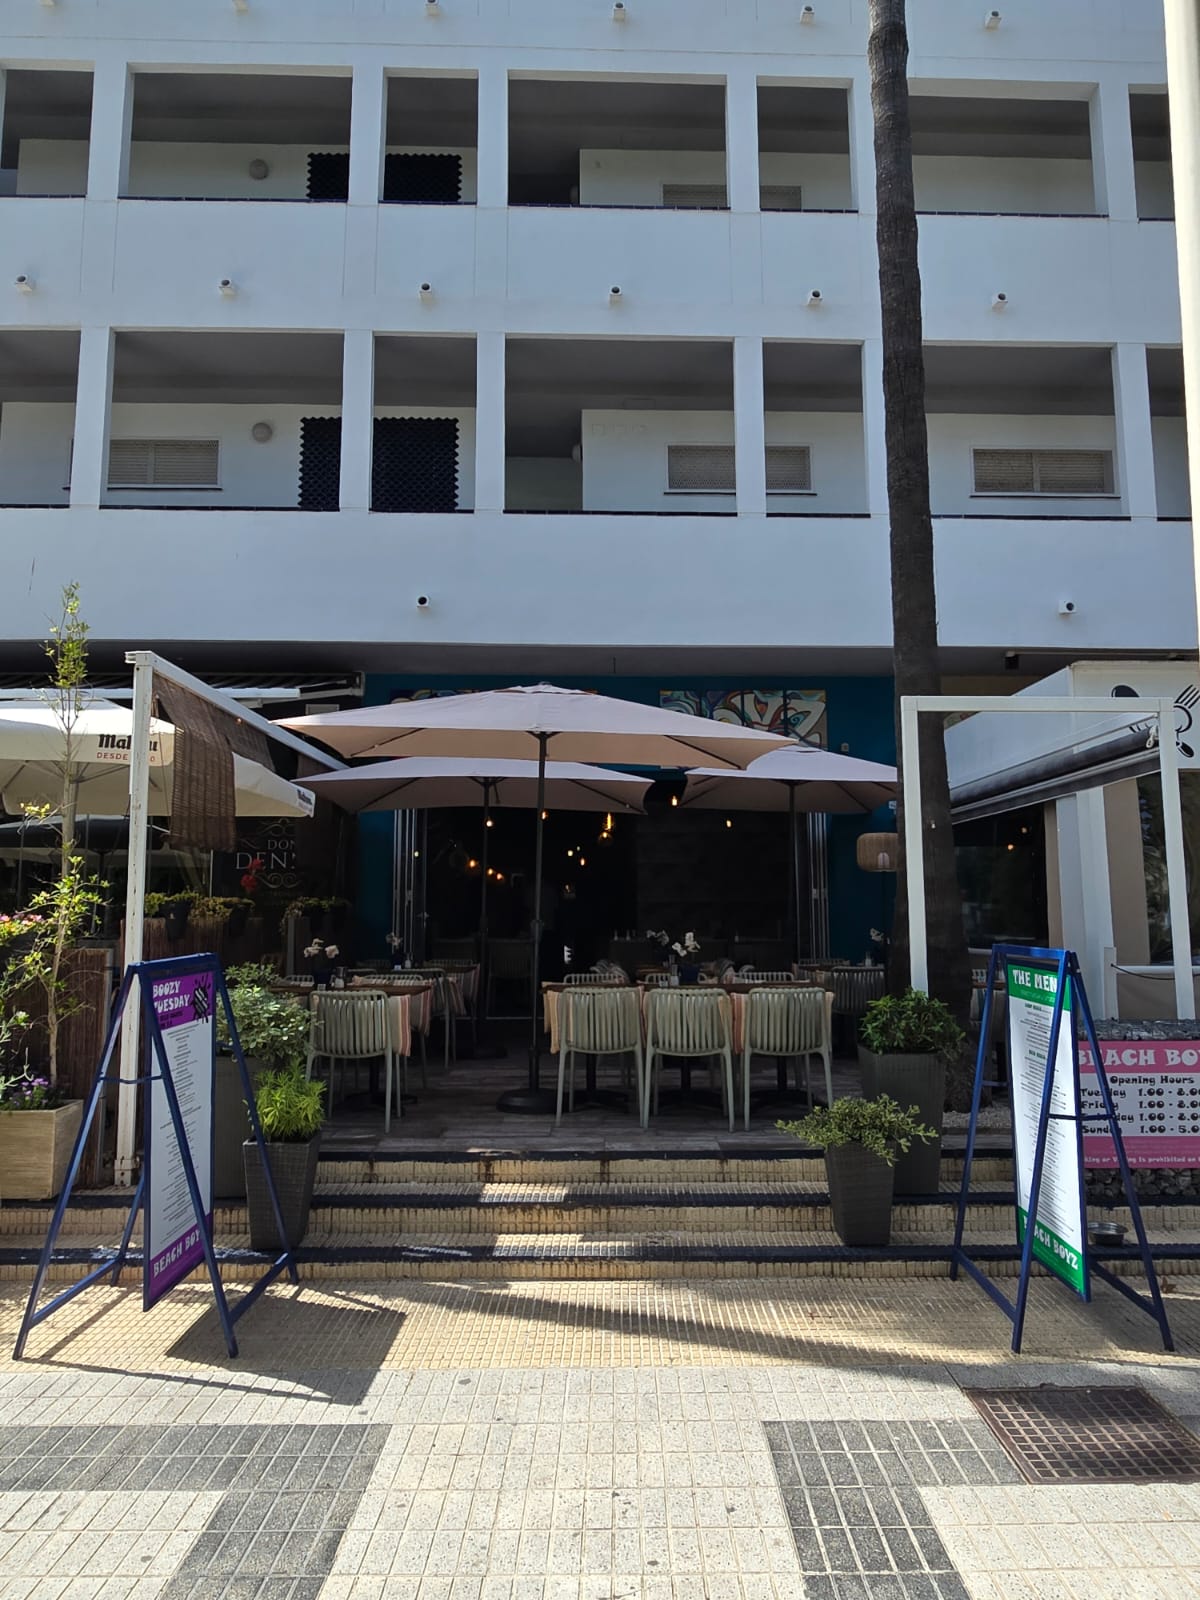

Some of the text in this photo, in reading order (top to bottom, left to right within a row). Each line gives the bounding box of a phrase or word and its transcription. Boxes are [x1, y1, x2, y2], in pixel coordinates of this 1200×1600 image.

[98, 734, 158, 752] Mau
[96, 752, 128, 760] DESDE
[1012, 969, 1058, 993] THE MEN
[153, 980, 181, 998] BOOZY
[1164, 1048, 1200, 1066] BO
[1160, 1075, 1194, 1084] Hours
[1138, 1088, 1164, 1096] 1.00
[1177, 1088, 1200, 1096] 8.0
[1138, 1100, 1165, 1109] 1.00
[1177, 1100, 1200, 1109] 8.0
[1139, 1113, 1165, 1121] 1.00
[1178, 1113, 1200, 1121] 8.0
[1140, 1125, 1166, 1133] 1.00
[153, 1229, 201, 1278] BEACH BOY
[1053, 1238, 1079, 1270] BOYZ
